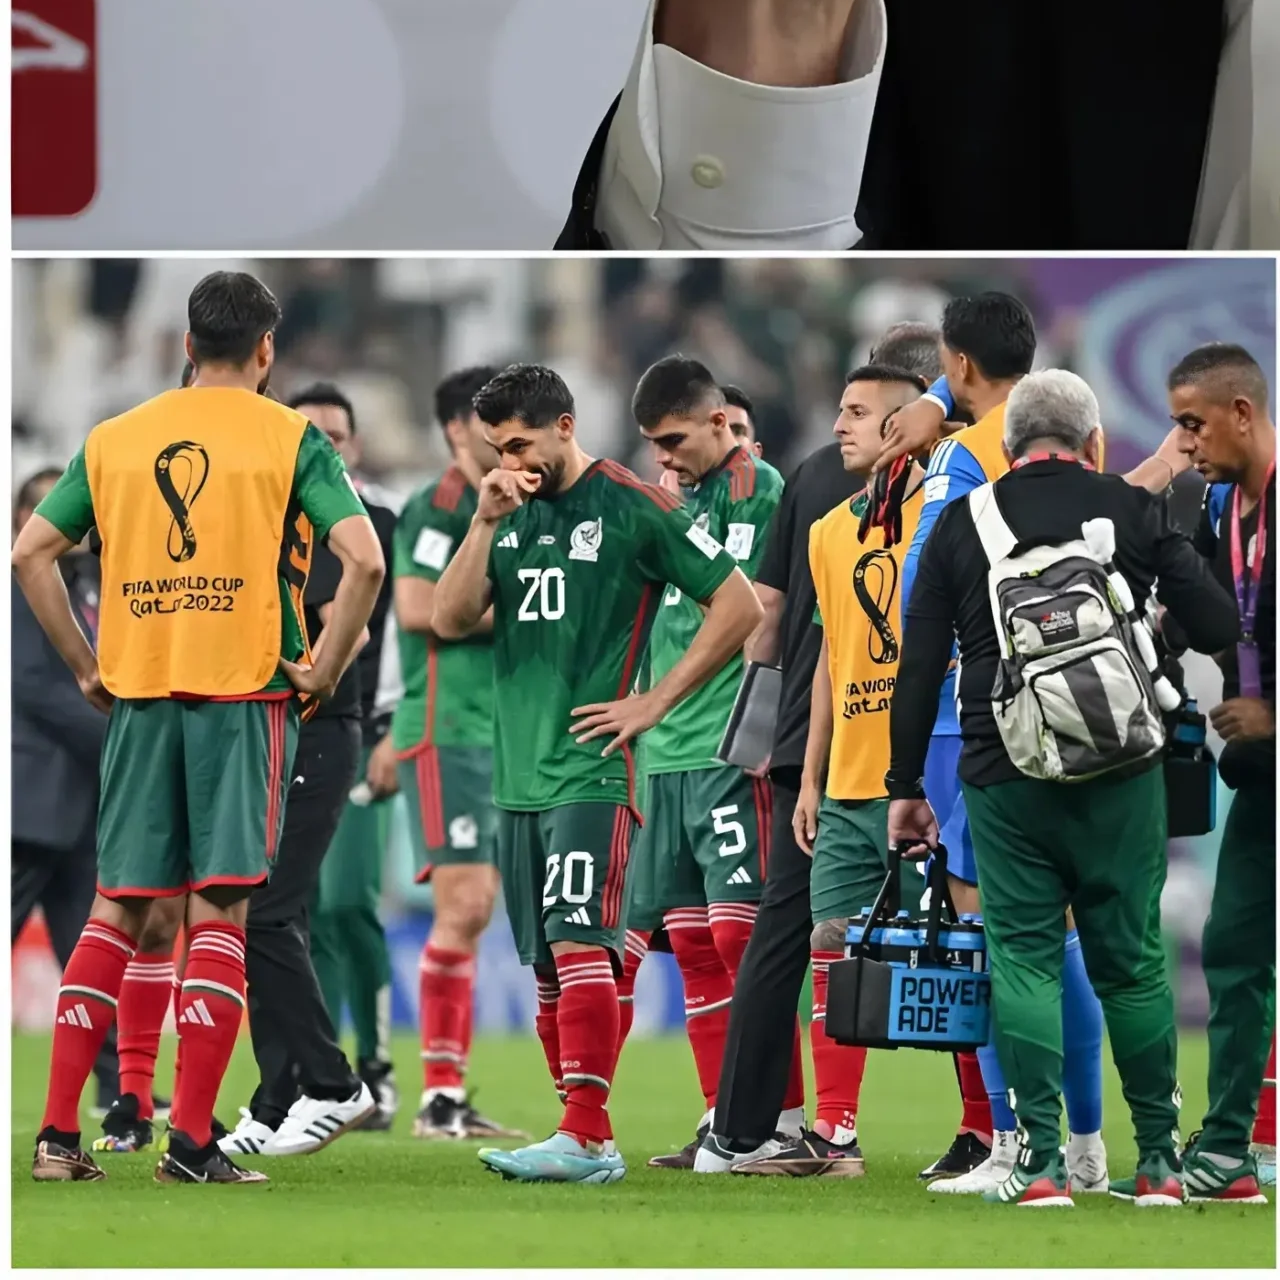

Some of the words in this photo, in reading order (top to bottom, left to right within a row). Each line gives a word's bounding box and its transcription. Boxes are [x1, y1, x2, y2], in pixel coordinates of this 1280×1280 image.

[211, 577, 244, 592] CUP
[517, 566, 566, 622] 20
[711, 804, 747, 858] 5
[542, 851, 595, 908] 20
[900, 976, 991, 1007] POWER
[897, 1005, 950, 1034] ADE
